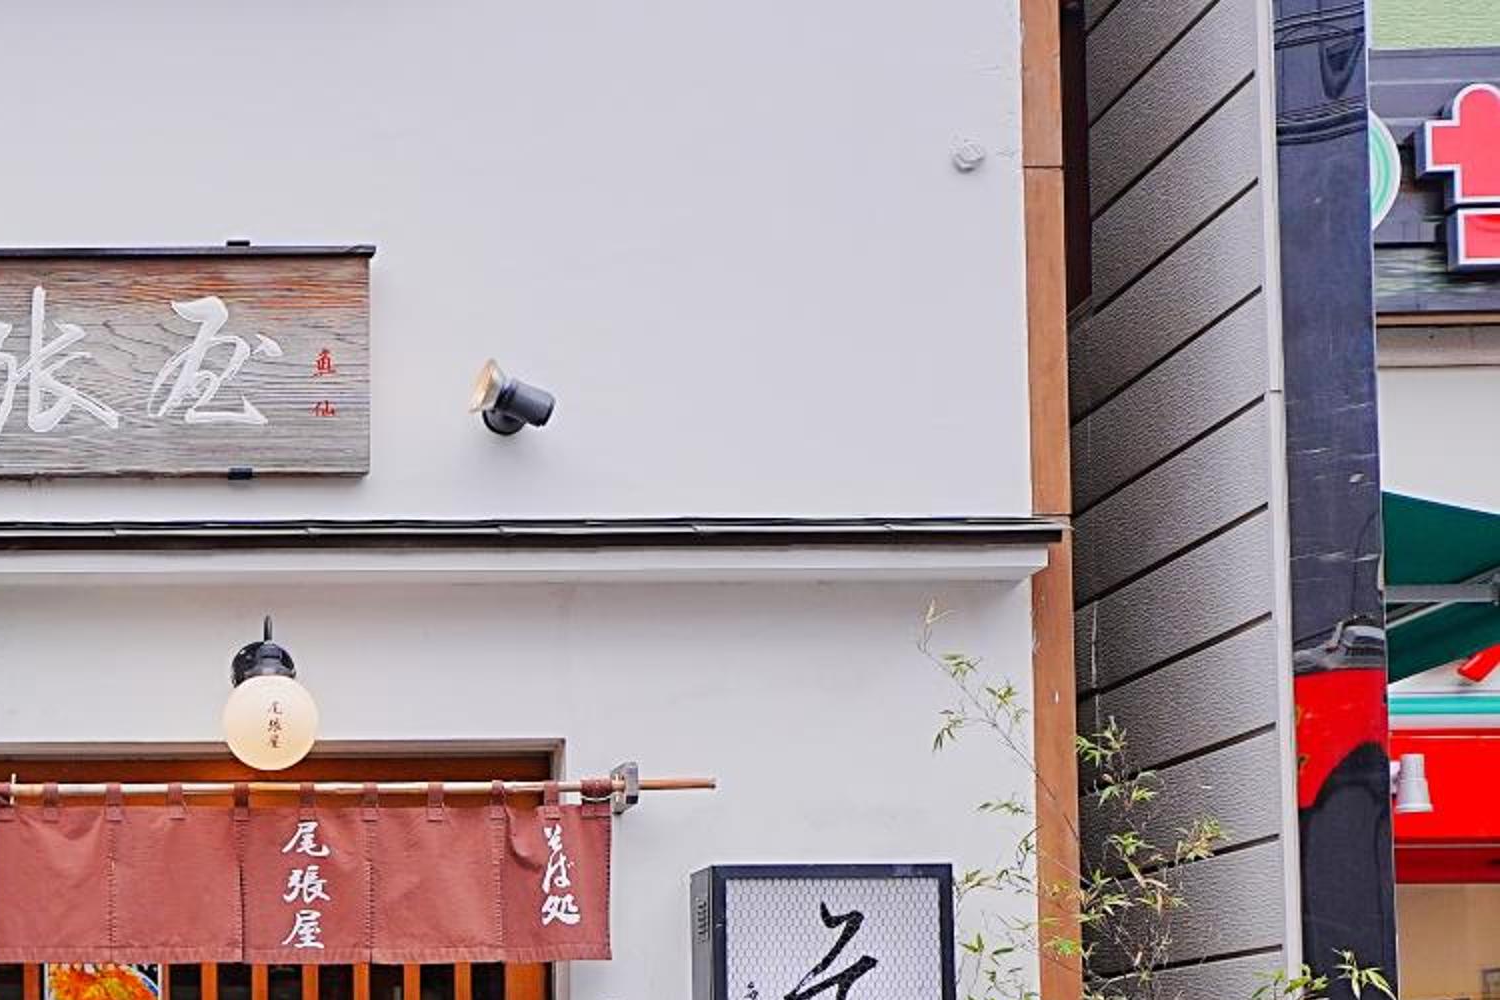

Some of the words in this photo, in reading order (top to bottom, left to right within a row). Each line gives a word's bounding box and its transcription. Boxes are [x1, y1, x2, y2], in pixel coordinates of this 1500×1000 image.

[267, 701, 284, 750] 尾張屋
[282, 820, 331, 949] 尾張屋
[541, 826, 581, 926] そば処
